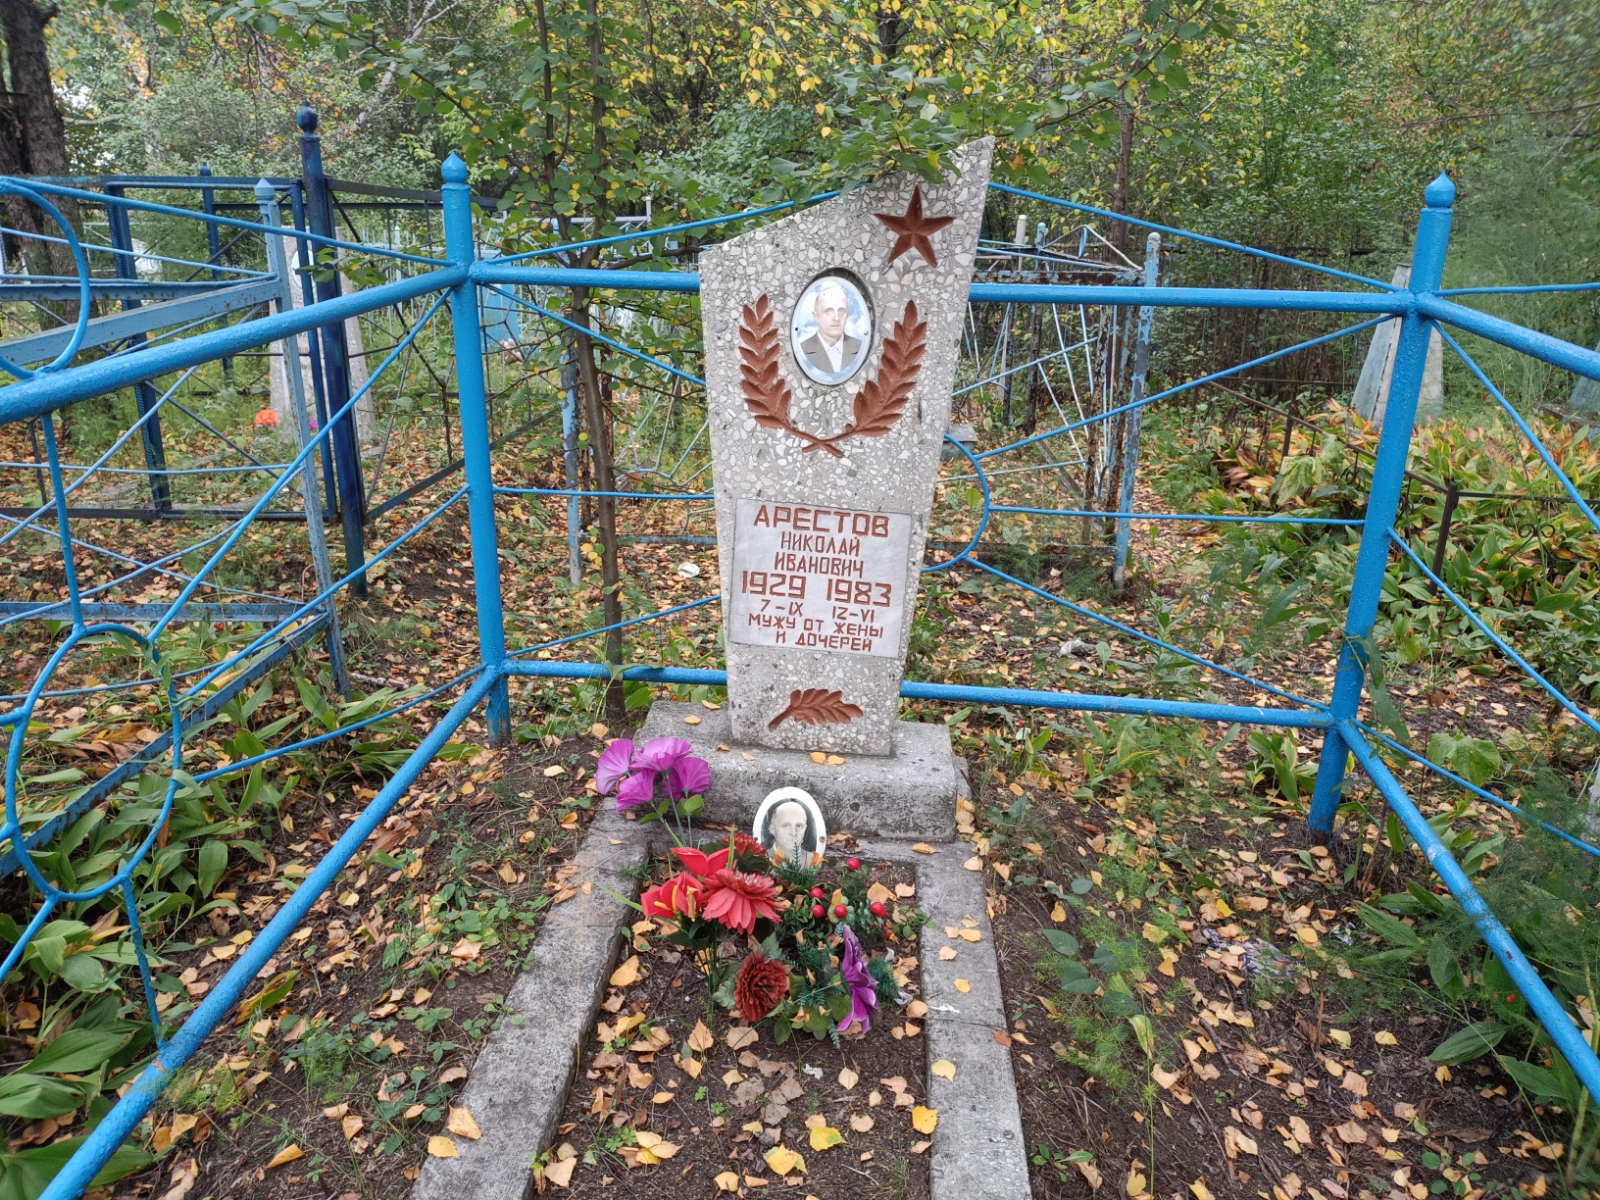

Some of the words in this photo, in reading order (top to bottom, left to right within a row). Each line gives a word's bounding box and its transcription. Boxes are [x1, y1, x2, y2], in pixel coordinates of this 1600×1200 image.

[753, 505, 890, 538] АРЕСТОВ
[781, 532, 860, 557] НИКОЛАЙ
[774, 552, 864, 578] ИВАНОВИЧ
[742, 571, 806, 599] 1929
[826, 579, 892, 607] 1983
[749, 613, 795, 629] МУЖУ
[804, 619, 824, 631] ОТ
[834, 622, 883, 638] ЖЕНЫ
[776, 631, 786, 644] И
[795, 633, 872, 652] ДОЧЕРЕЙ
